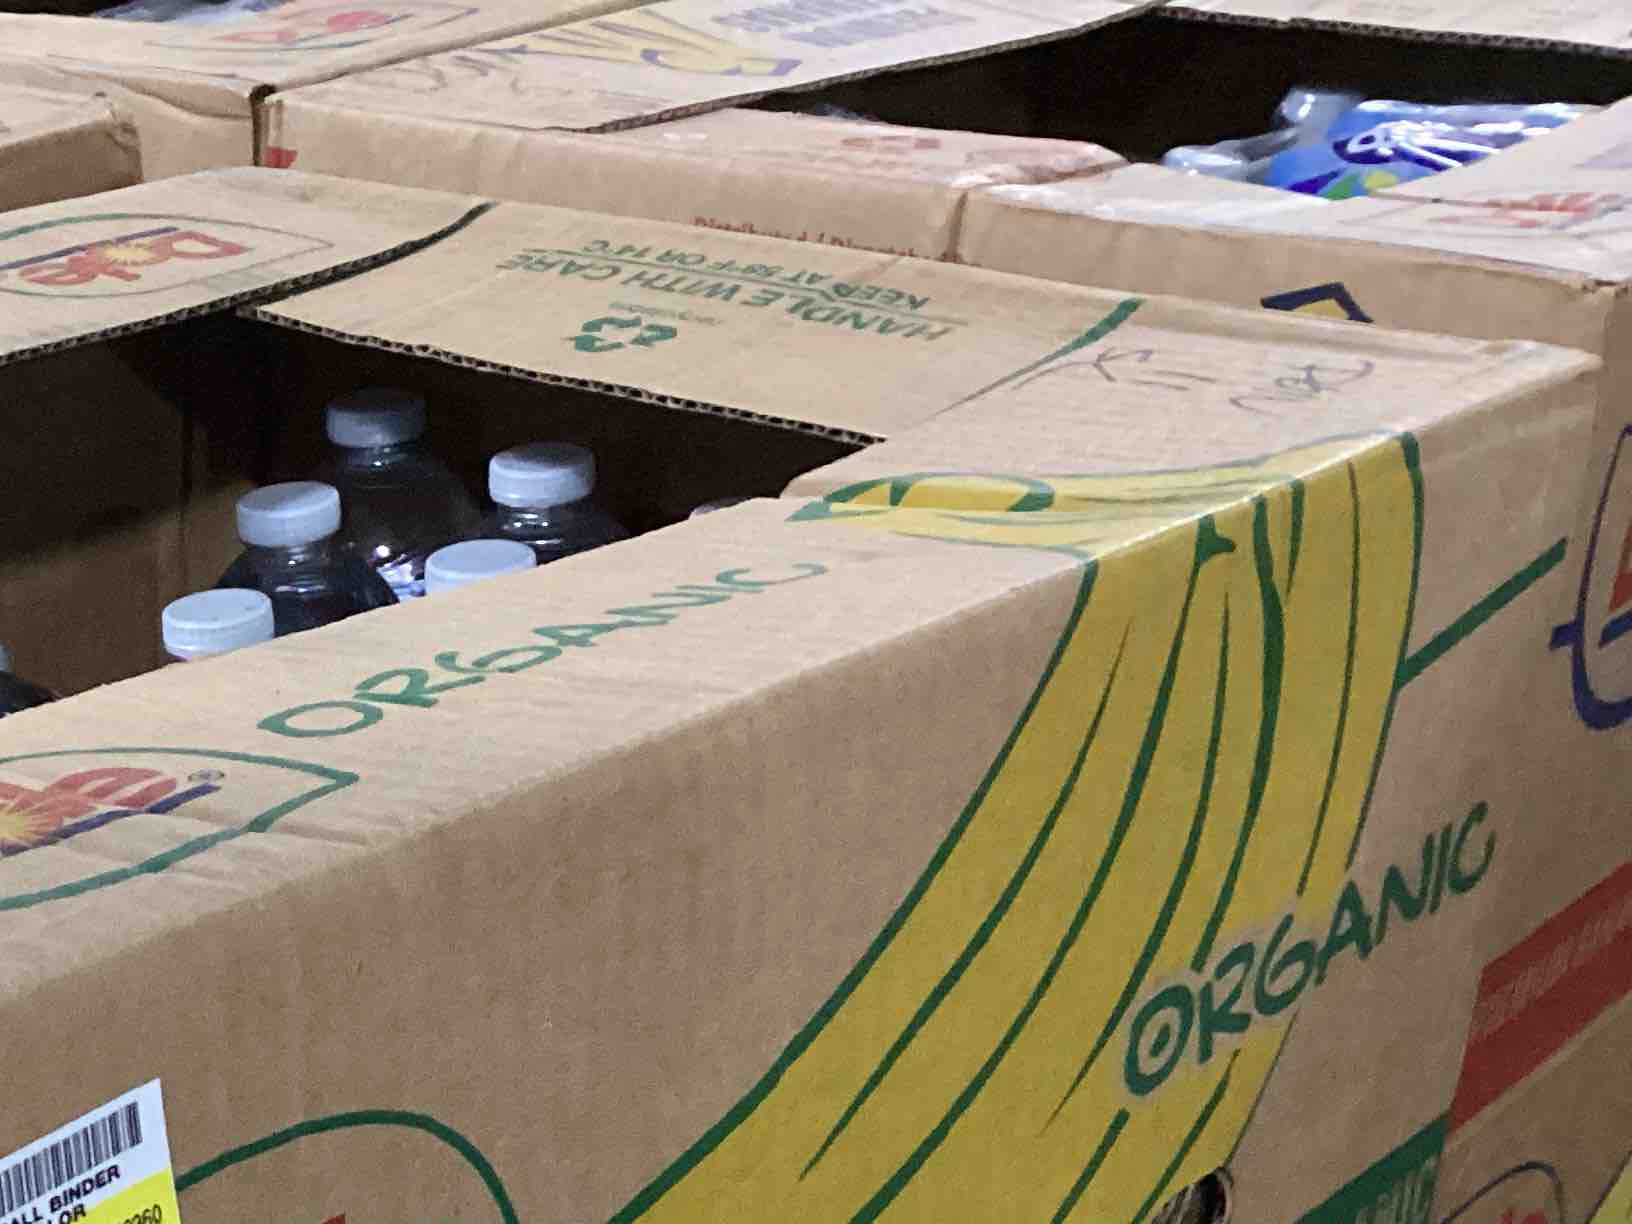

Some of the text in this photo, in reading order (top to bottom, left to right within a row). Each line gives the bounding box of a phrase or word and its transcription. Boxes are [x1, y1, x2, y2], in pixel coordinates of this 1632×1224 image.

[15, 225, 250, 288] Dole
[496, 254, 622, 281] CARE
[621, 270, 741, 302] WITH
[741, 289, 953, 342] HANDLE
[257, 561, 829, 739] ORGANIC
[1120, 801, 1498, 1097] ORGANIC
[49, 1163, 122, 1215] BINDER
